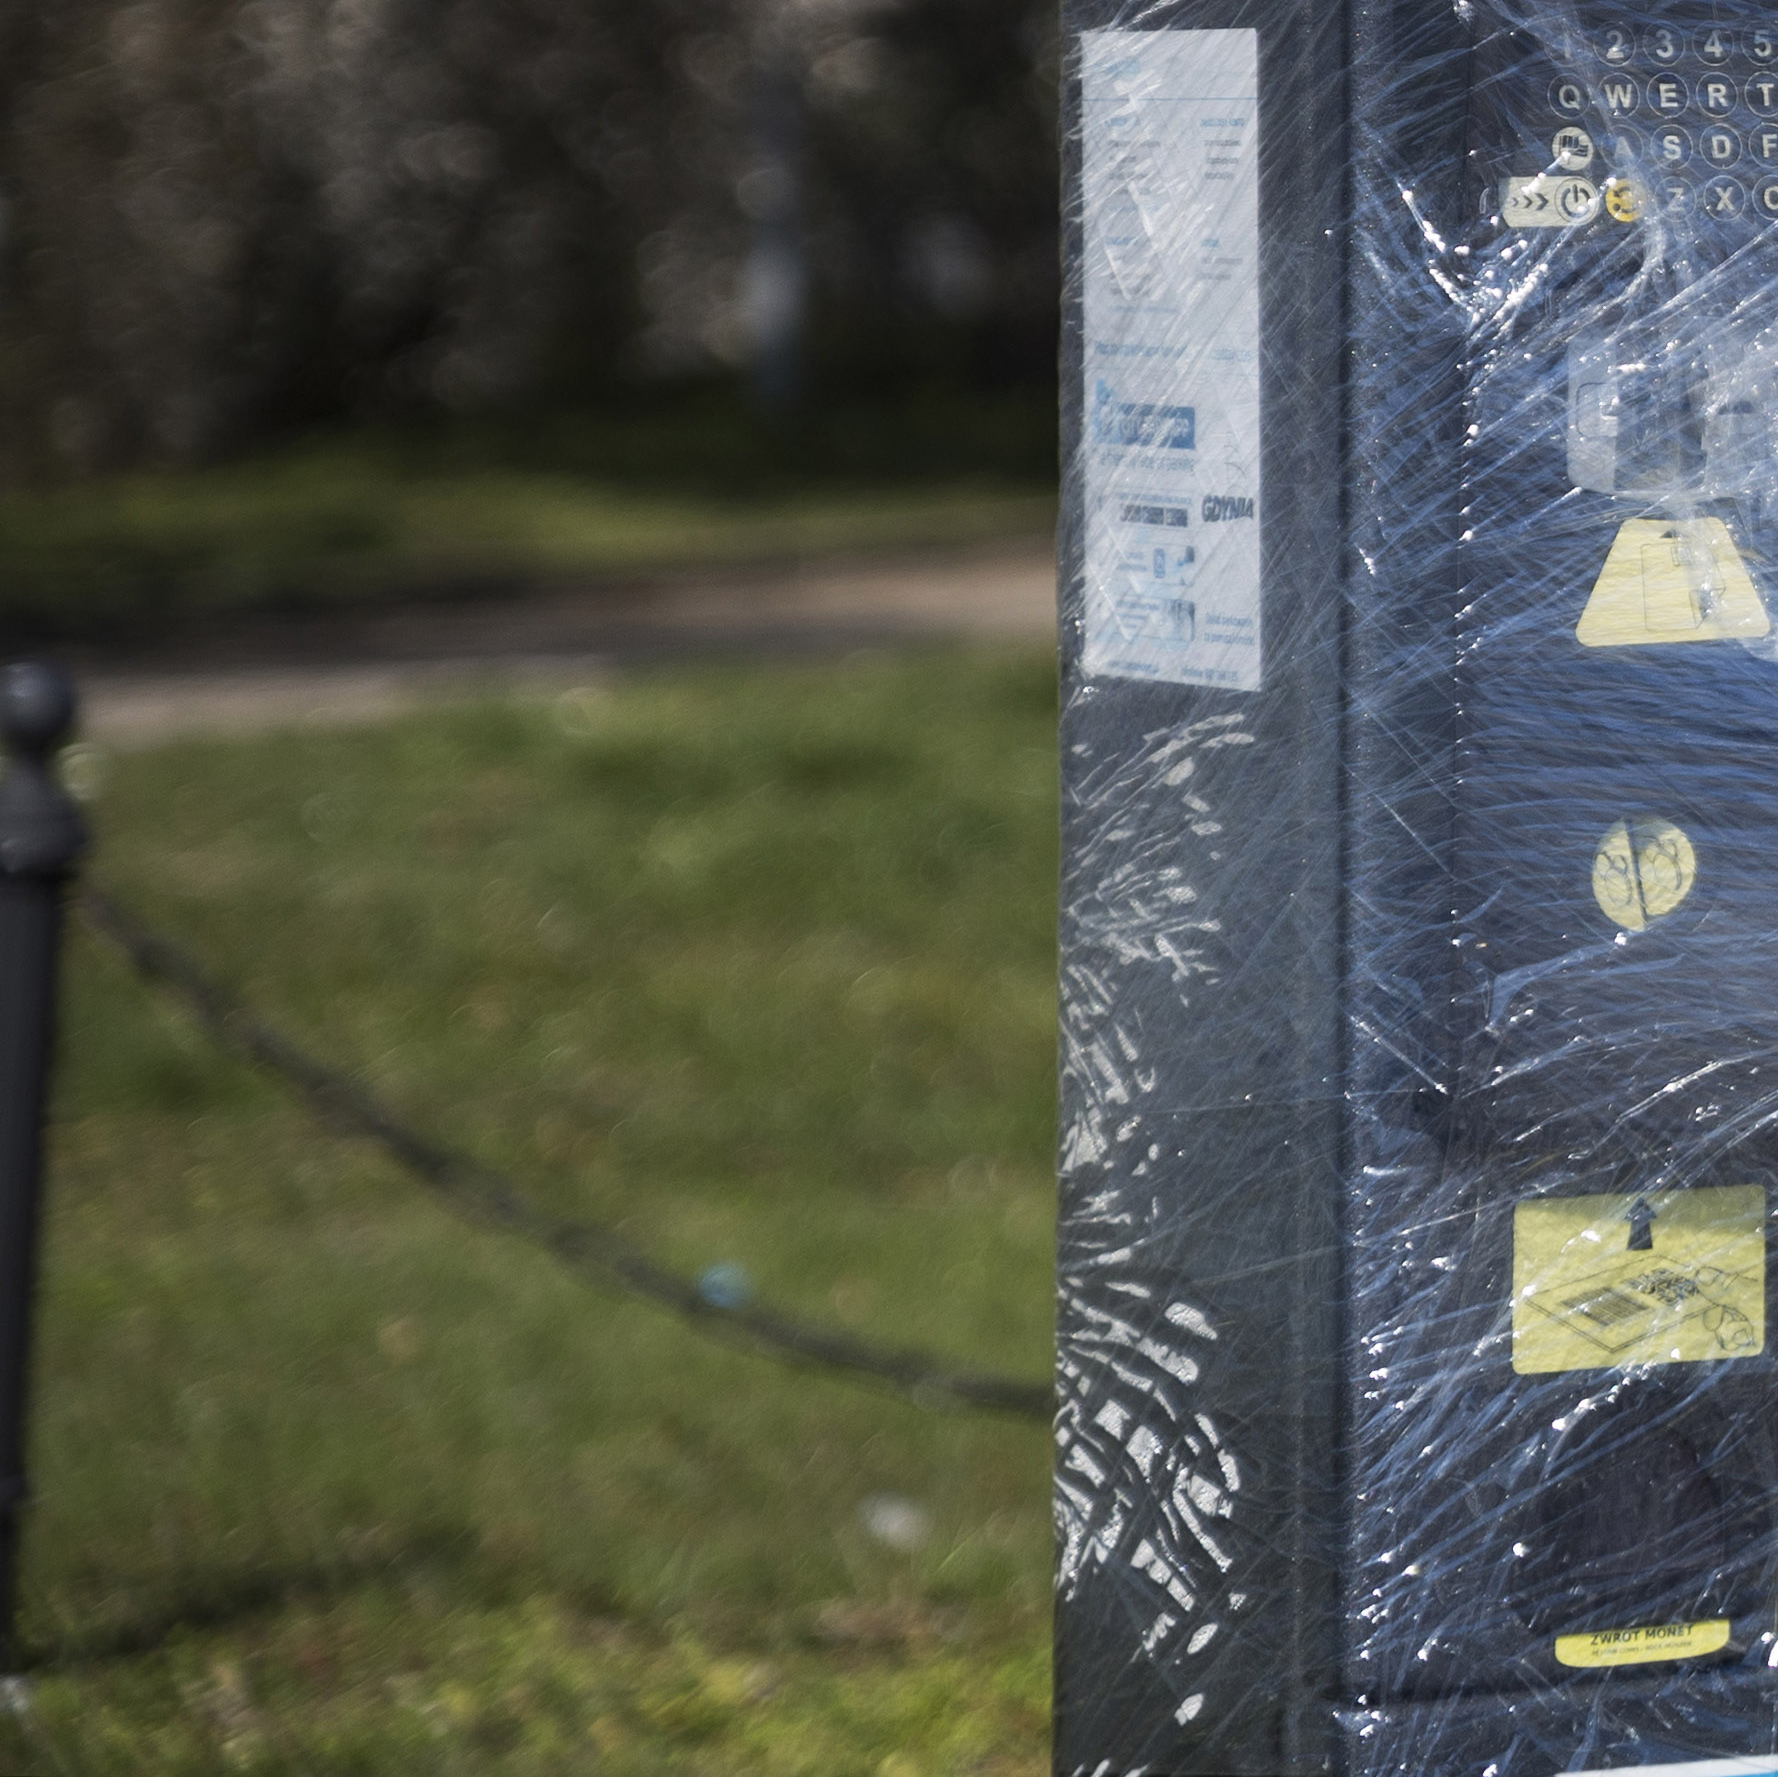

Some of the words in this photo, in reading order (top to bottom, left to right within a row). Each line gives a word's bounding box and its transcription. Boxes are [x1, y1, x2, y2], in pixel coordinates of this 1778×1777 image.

[1606, 30, 1625, 60] 2
[1655, 29, 1674, 58] 3
[1704, 30, 1724, 58] 4
[1754, 29, 1772, 57] 5
[1558, 84, 1581, 111] Q
[1604, 84, 1633, 109] W
[1658, 82, 1679, 108] E
[1707, 83, 1729, 108] R
[1756, 82, 1775, 107] T
[1614, 135, 1634, 160] A
[1662, 134, 1682, 160] S
[1712, 134, 1731, 159] D
[1762, 134, 1778, 159] F
[1666, 187, 1686, 212] Z
[1714, 186, 1735, 211] X
[1202, 494, 1254, 523] GDYNIA
[1590, 1629, 1641, 1646] ZWROT
[1644, 1624, 1694, 1641] MONET
